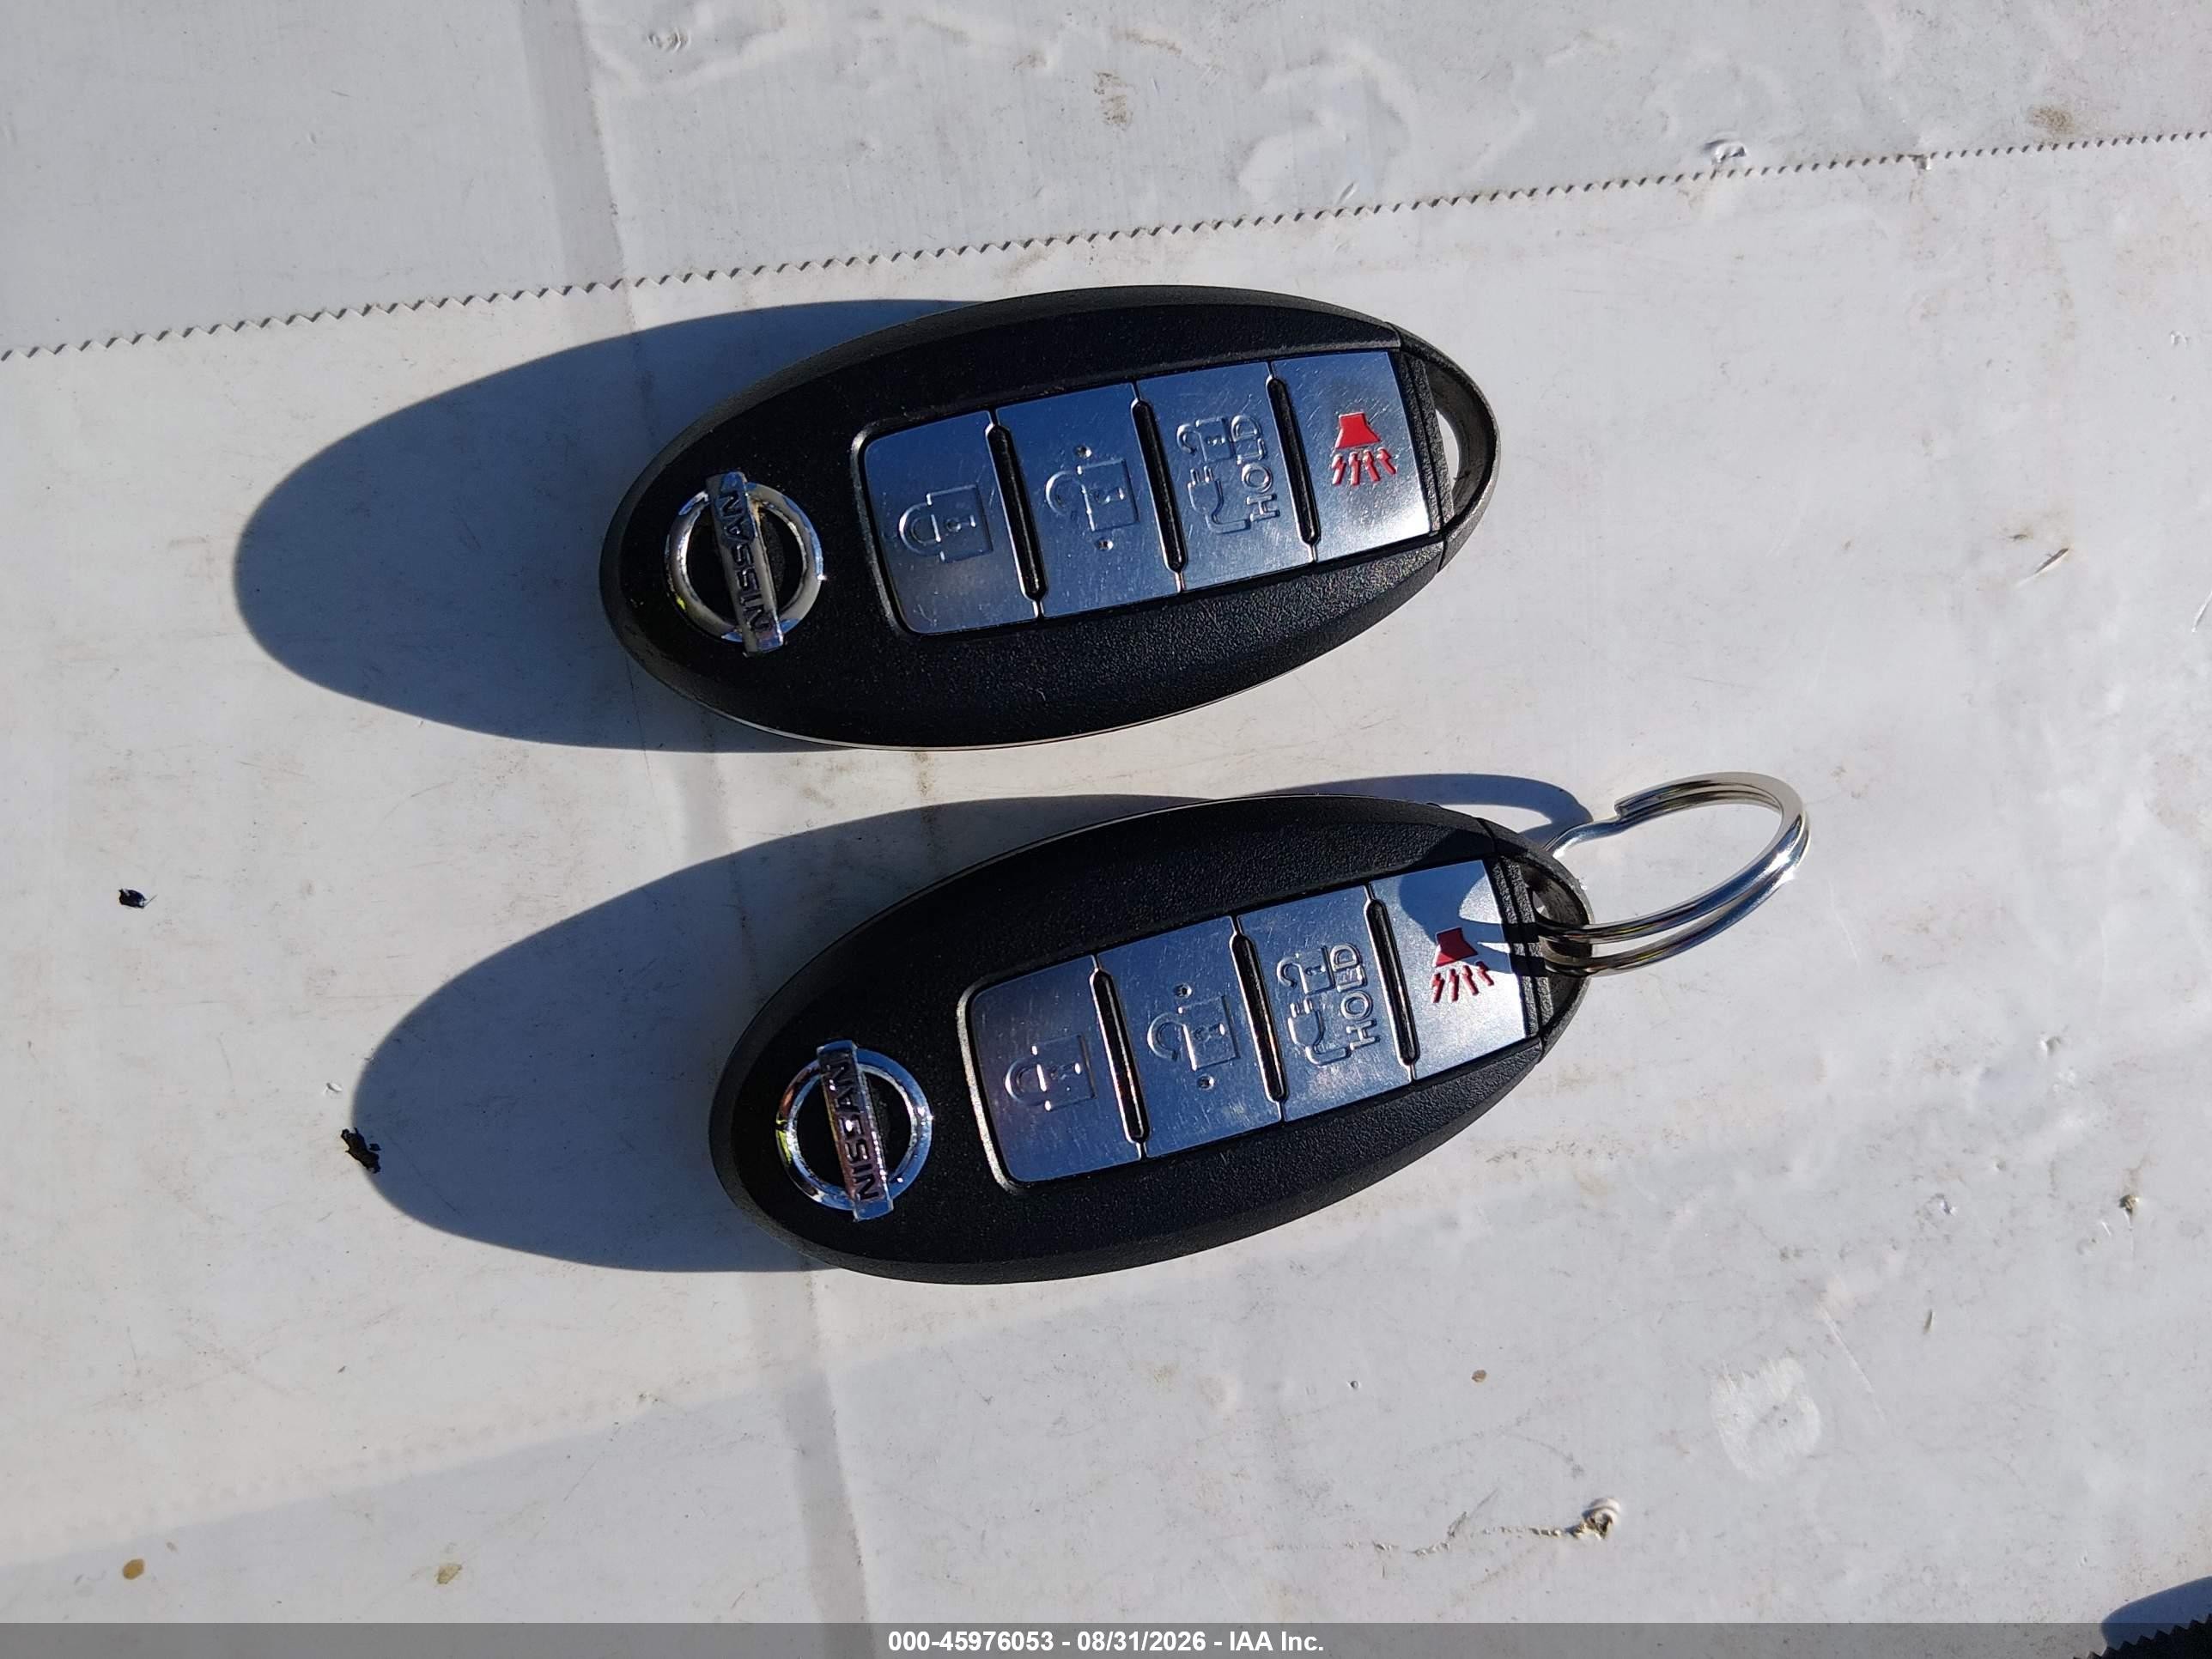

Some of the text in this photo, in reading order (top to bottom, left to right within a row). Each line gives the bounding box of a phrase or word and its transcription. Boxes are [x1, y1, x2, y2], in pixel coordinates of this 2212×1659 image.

[1231, 415, 1280, 523] HOLD
[718, 490, 771, 631] NISSAN
[1329, 943, 1381, 1051] HOLD
[823, 1059, 880, 1200] NISSAN
